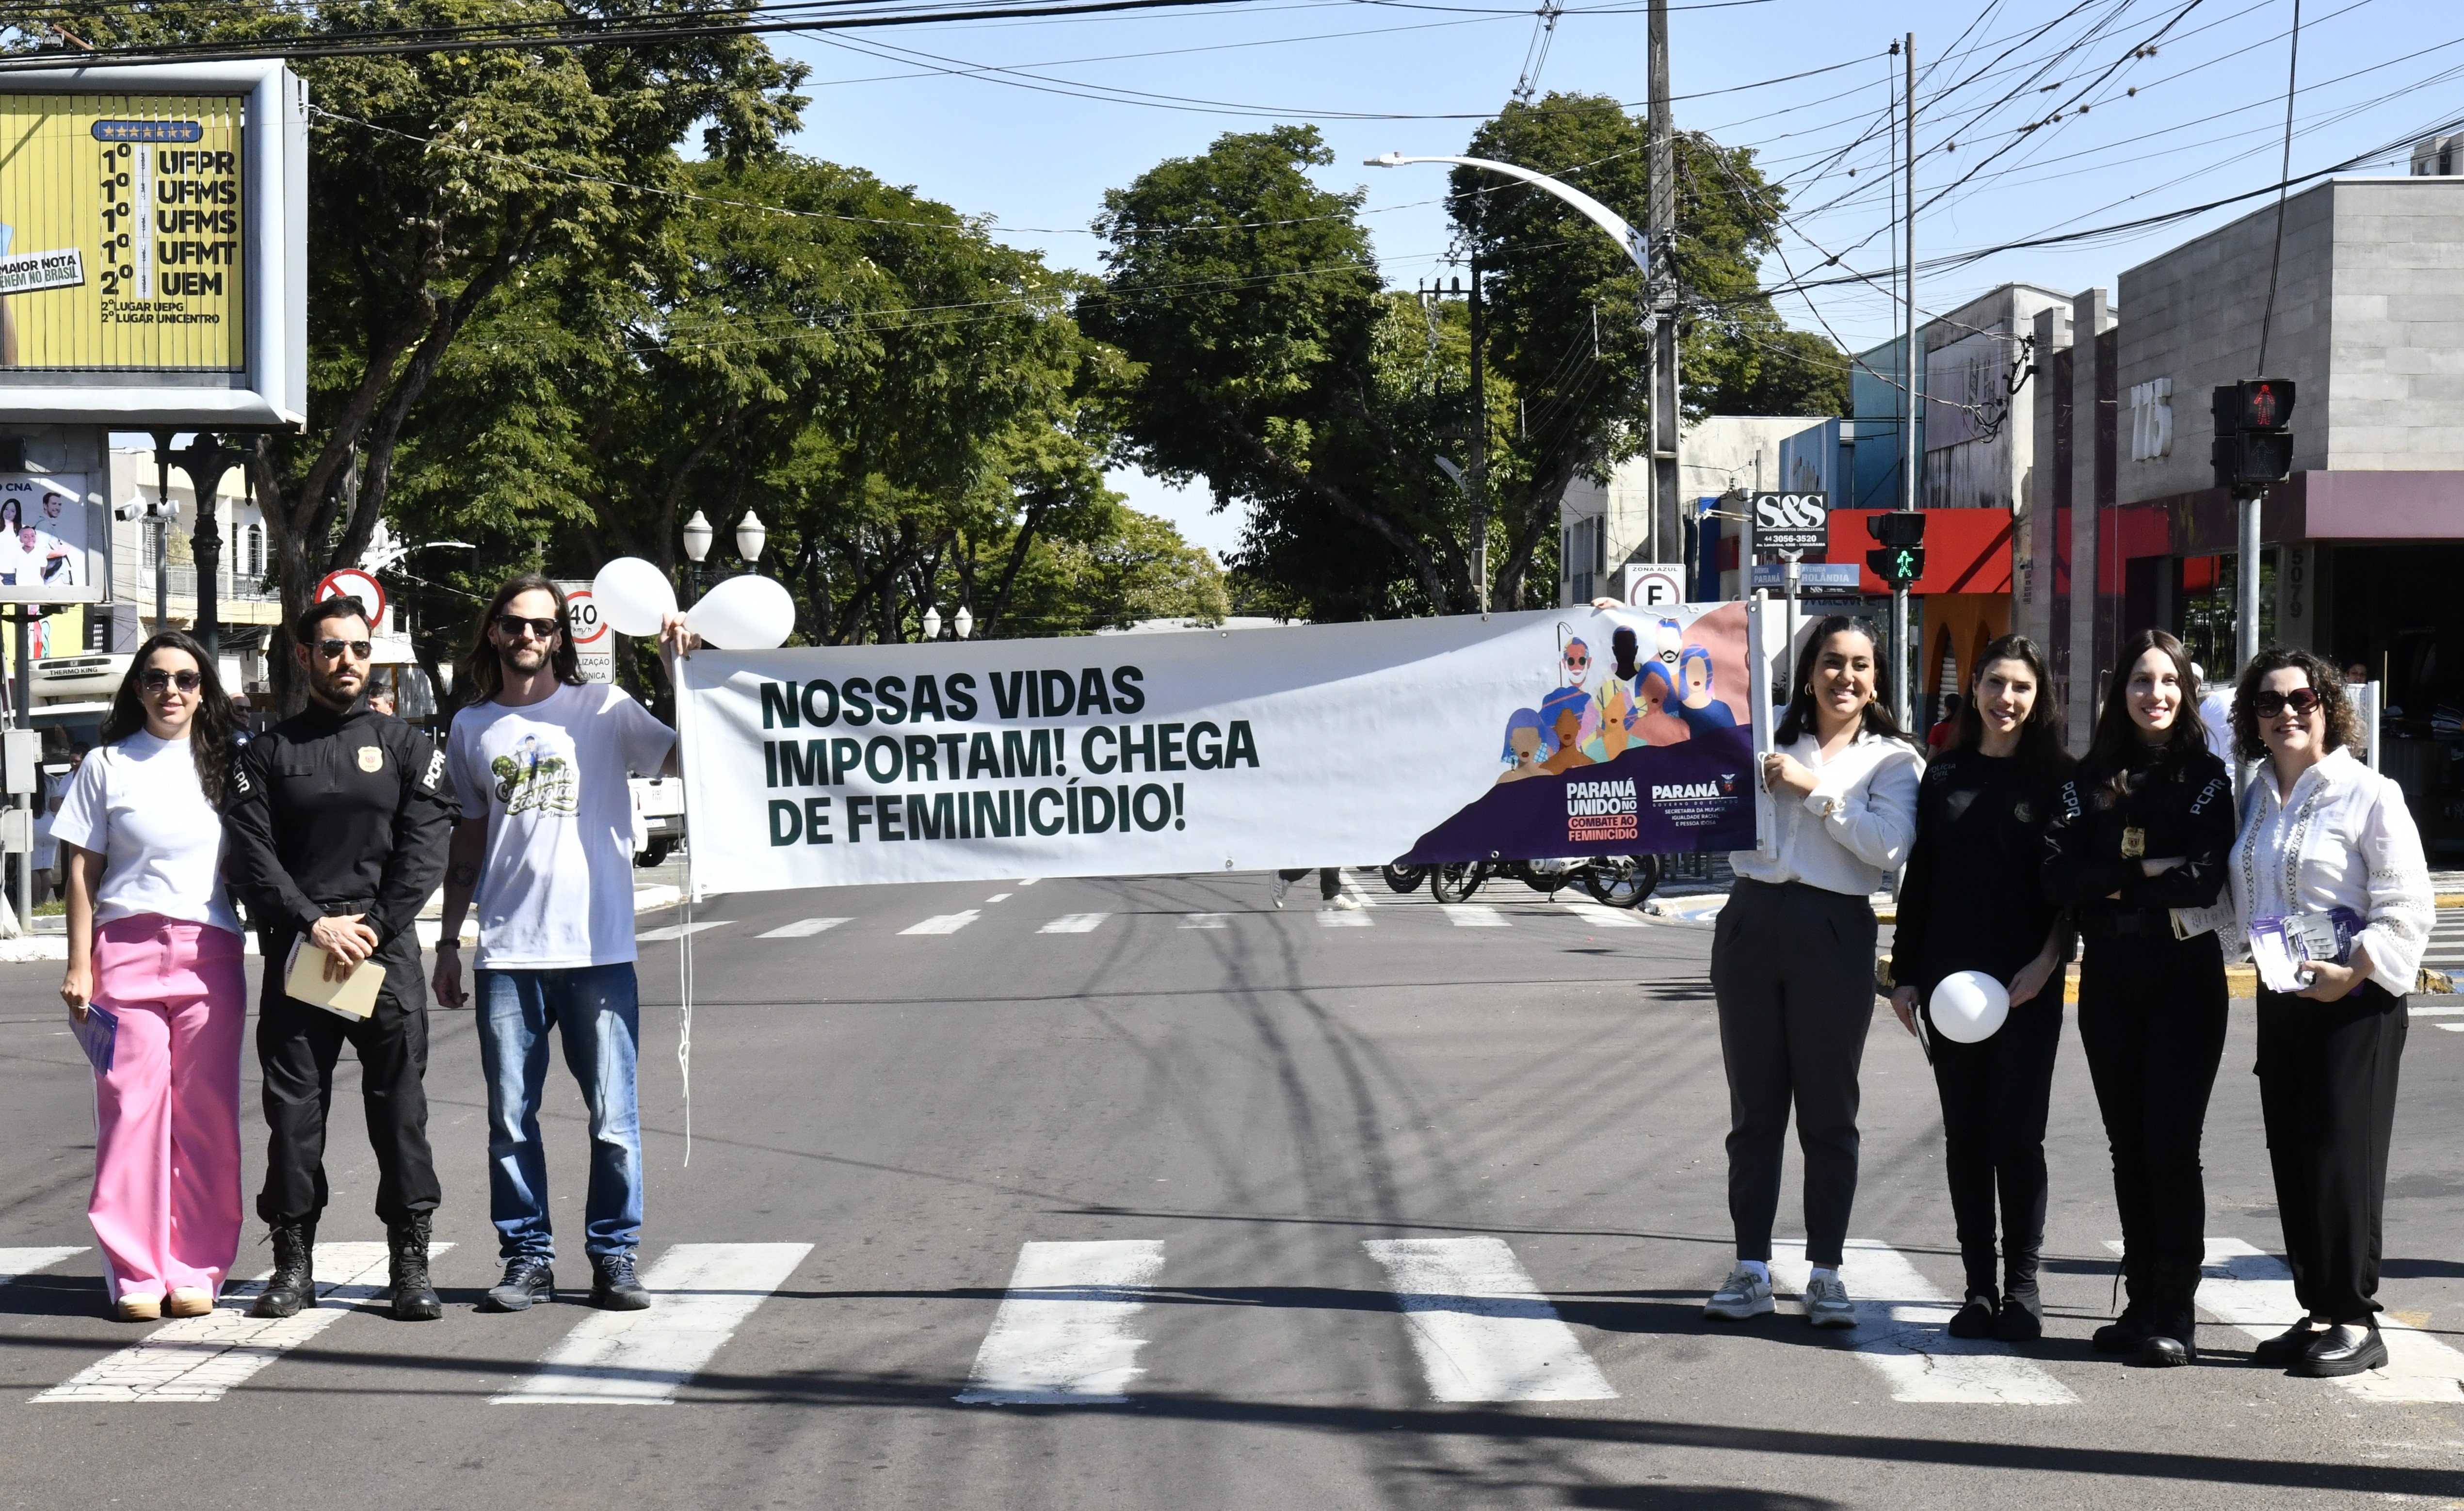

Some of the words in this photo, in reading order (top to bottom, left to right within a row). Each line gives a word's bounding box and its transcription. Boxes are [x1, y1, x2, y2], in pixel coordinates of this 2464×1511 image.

[160, 151, 235, 175] UFPR
[158, 180, 237, 204] UFMS
[159, 210, 237, 234] UFMS
[0, 260, 38, 274] MAIOR
[41, 255, 76, 269] NOTA
[159, 241, 237, 265] UFMT
[29, 271, 42, 284] NO
[45, 266, 78, 282] BRASIL
[161, 273, 222, 296] UEM
[116, 314, 154, 323] LUGAR
[157, 314, 220, 323] UNICENTRO
[154, 303, 183, 312] UEPG
[2131, 378, 2173, 462] 115
[6, 483, 32, 491] CNA
[1756, 495, 1826, 528] S&S
[1754, 573, 1780, 583] PARANÁ
[1802, 572, 1850, 582] ROLÂNDIA
[2290, 548, 2303, 618] 5079
[570, 605, 597, 625] 40
[760, 673, 978, 729] NOSSAS
[988, 665, 1145, 720] VIDAS
[763, 728, 1067, 788] IMPORTAM!
[1081, 720, 1260, 775] CHEGA
[423, 750, 446, 789] PCPR
[496, 763, 576, 803] Caminhada
[1567, 777, 1637, 799] PARANÁ
[1652, 780, 1720, 799] PARANÁ
[505, 780, 579, 816] Ecológica
[652, 790, 662, 800] FIAT
[2061, 781, 2081, 817] PCPR
[2190, 778, 2225, 815] PCPR
[768, 797, 833, 847] DE
[846, 777, 1186, 843] FEMINICÍDIO!
[1567, 798, 1621, 816] UNIDO
[1622, 800, 1637, 810] NO
[1571, 817, 1618, 828] COMBATE
[1620, 816, 1634, 826] AO
[1568, 827, 1638, 841] FEMINICÍDIO
